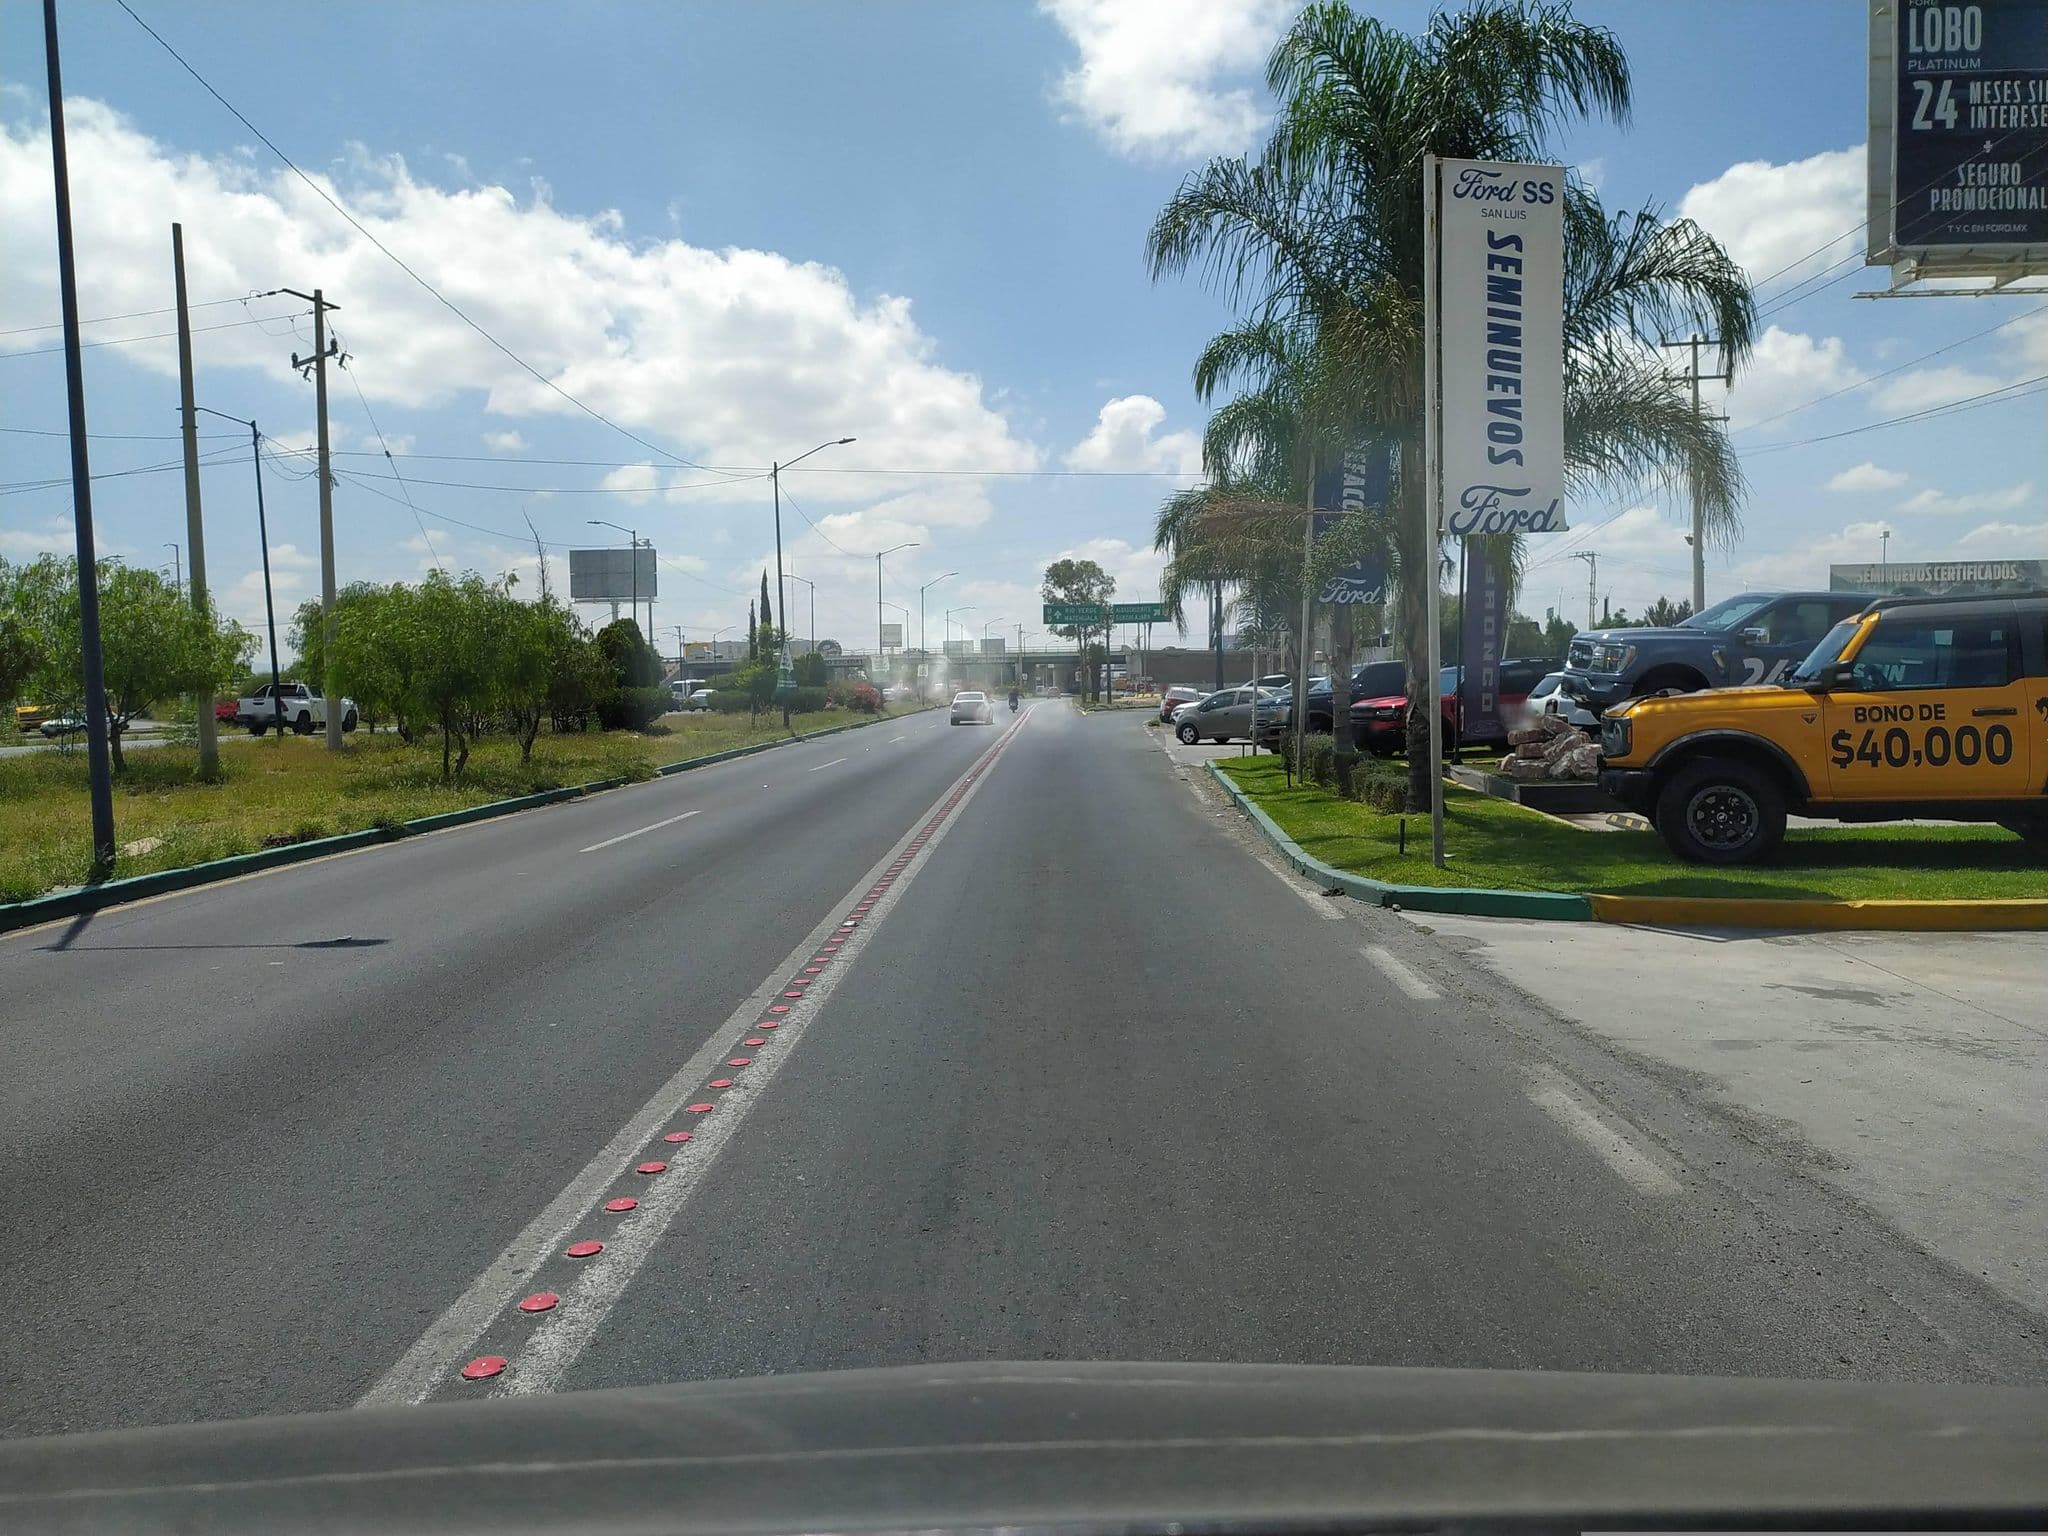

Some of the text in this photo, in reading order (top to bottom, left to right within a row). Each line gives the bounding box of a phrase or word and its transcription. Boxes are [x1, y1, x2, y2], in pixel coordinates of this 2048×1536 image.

[1908, 6, 1982, 53] LOBO
[1908, 58, 1981, 71] PLATINUM
[1912, 79, 1958, 130] 24
[1969, 80, 2021, 104] MESES
[1453, 168, 1554, 204] Ford SS
[1957, 162, 2022, 187] SEGURO
[1930, 186, 2047, 212] PROMOCIONAL
[1481, 208, 1527, 220] SAN LUIS
[1486, 229, 1524, 468] SEMINUEVOS
[1448, 484, 1560, 536] Ford
[1933, 563, 2018, 582] CERTIFICADOS
[1318, 576, 1382, 604] Ford
[1854, 703, 1946, 724] BONO DE
[1830, 723, 2014, 769] $40,000
